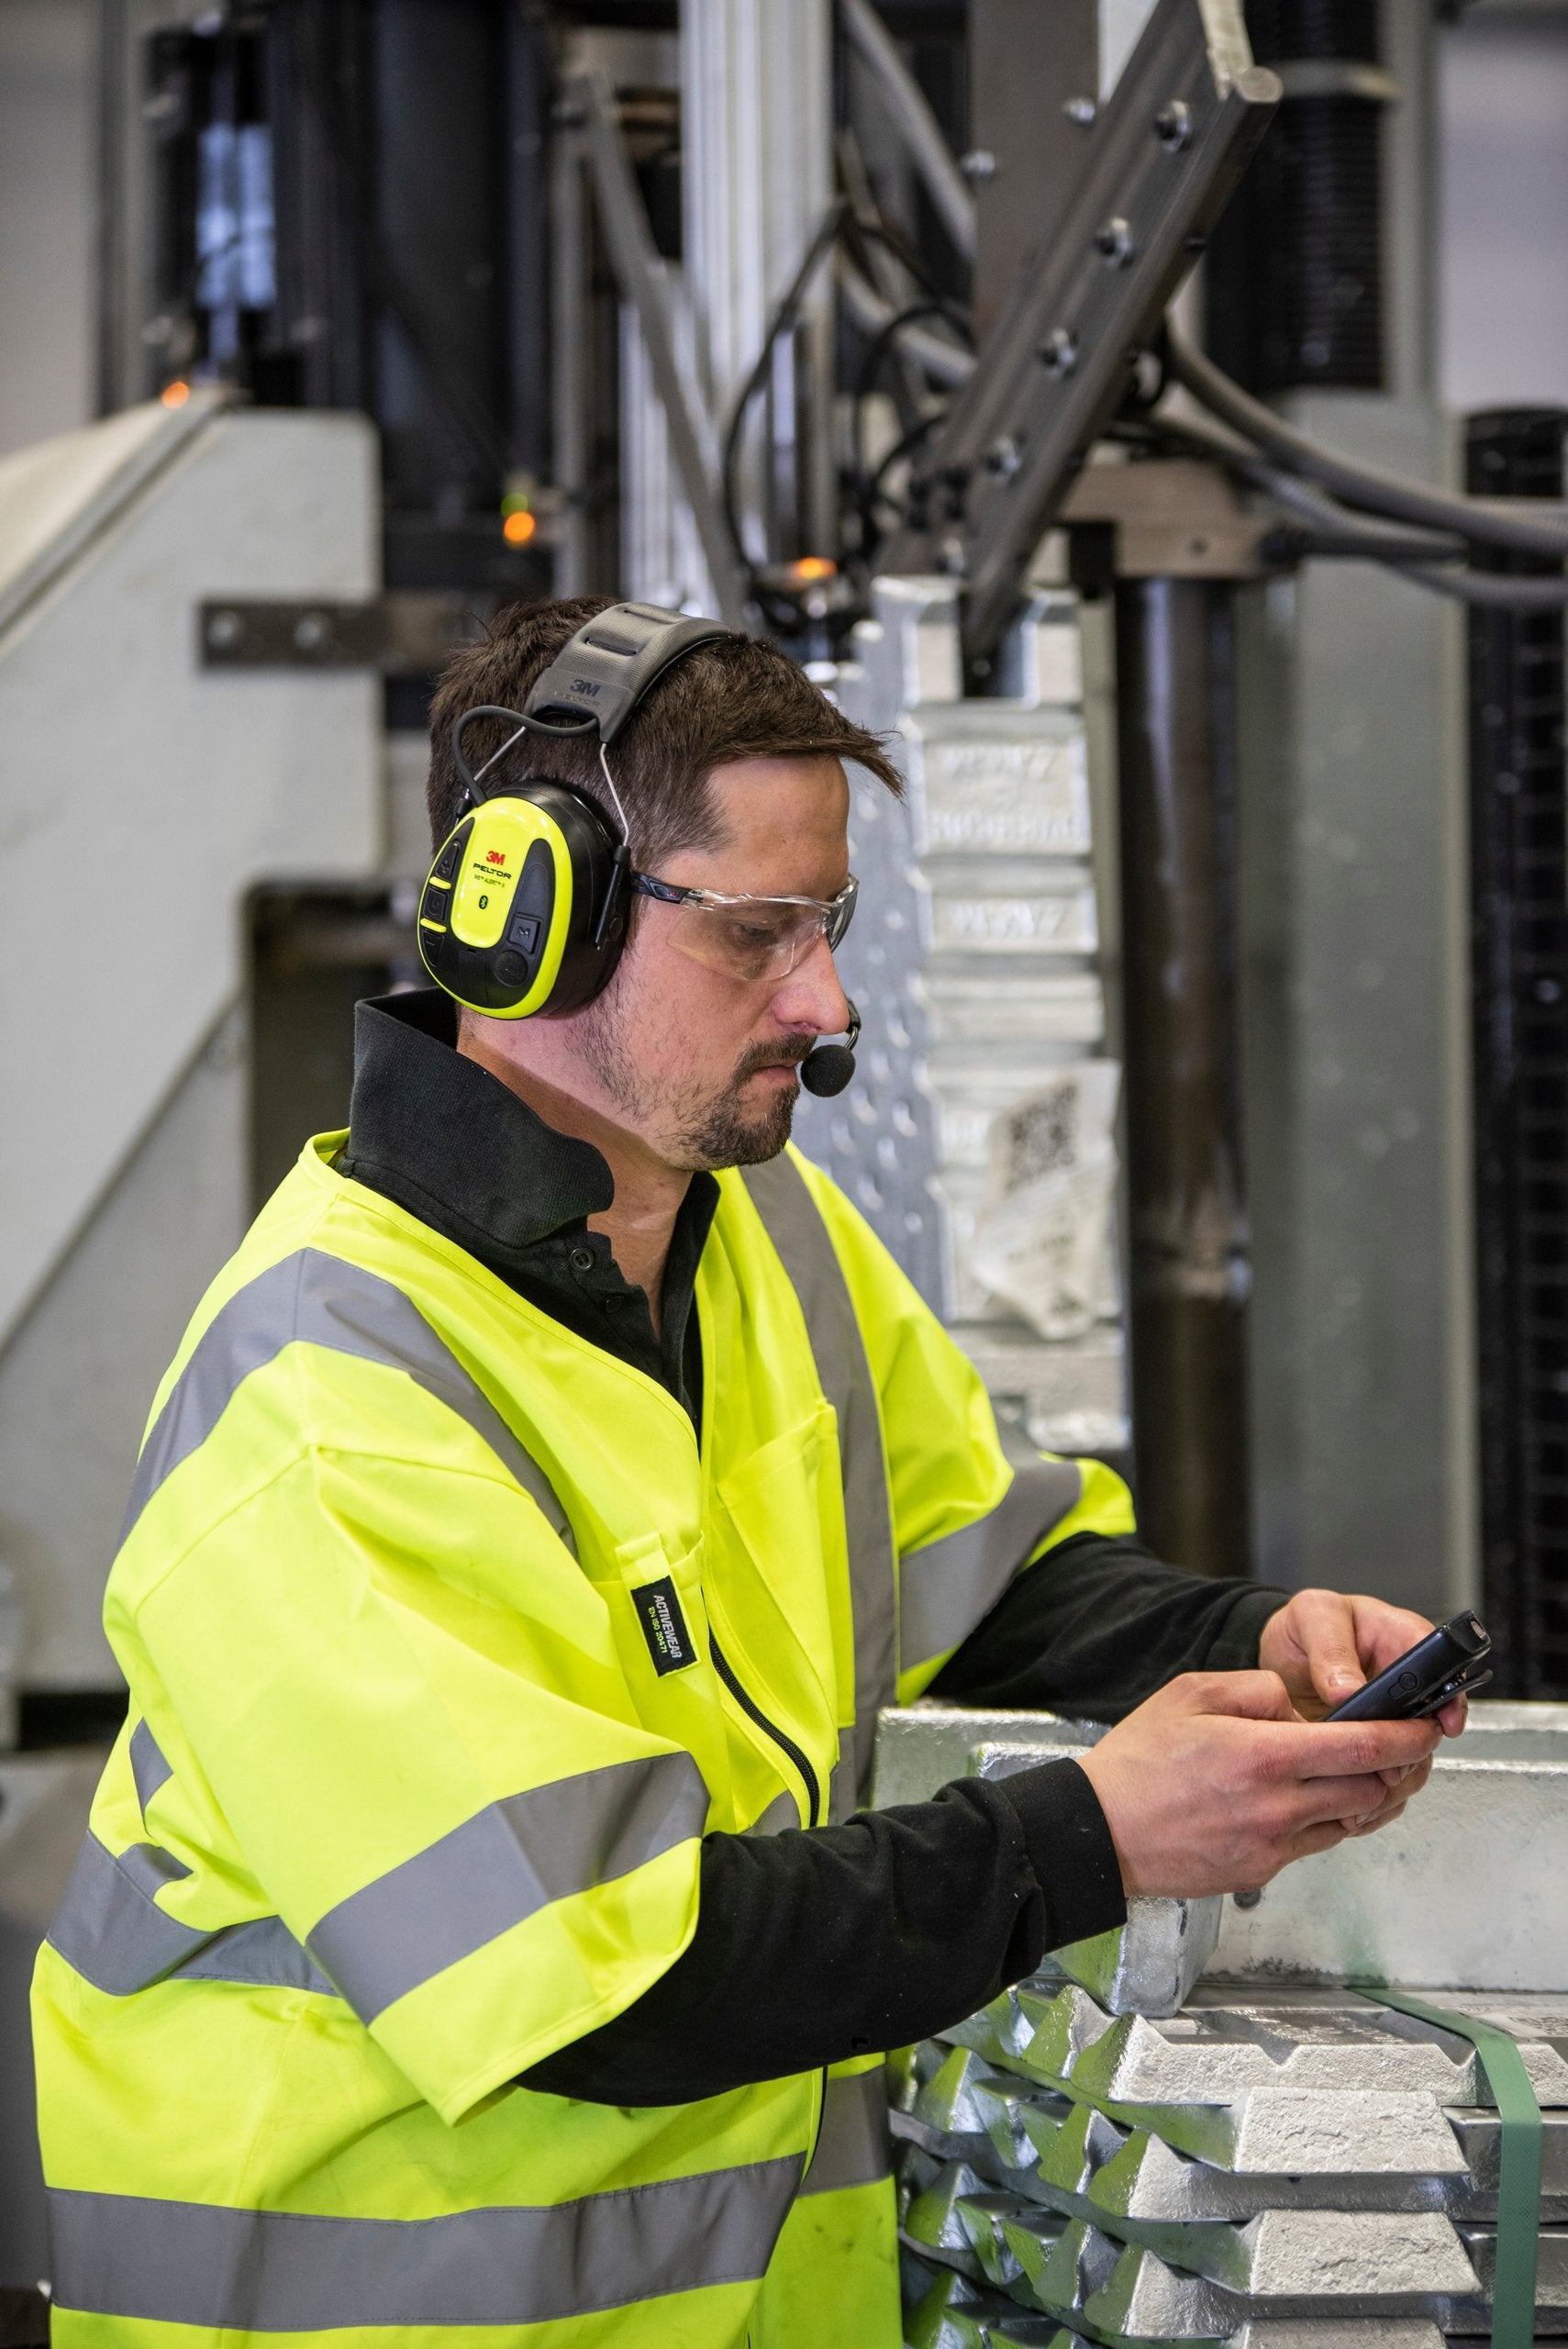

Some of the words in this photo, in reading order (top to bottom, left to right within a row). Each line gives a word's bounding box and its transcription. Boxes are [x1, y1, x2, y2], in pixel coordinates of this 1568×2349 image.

[570, 679, 602, 697] 3M
[486, 850, 506, 866] 3M
[473, 863, 512, 880] PELTOR
[648, 1606, 656, 1618] EN
[651, 1618, 661, 1631] ISO
[653, 1595, 683, 1659] ACTIVEWEAR
[655, 1631, 668, 1653] 20471
